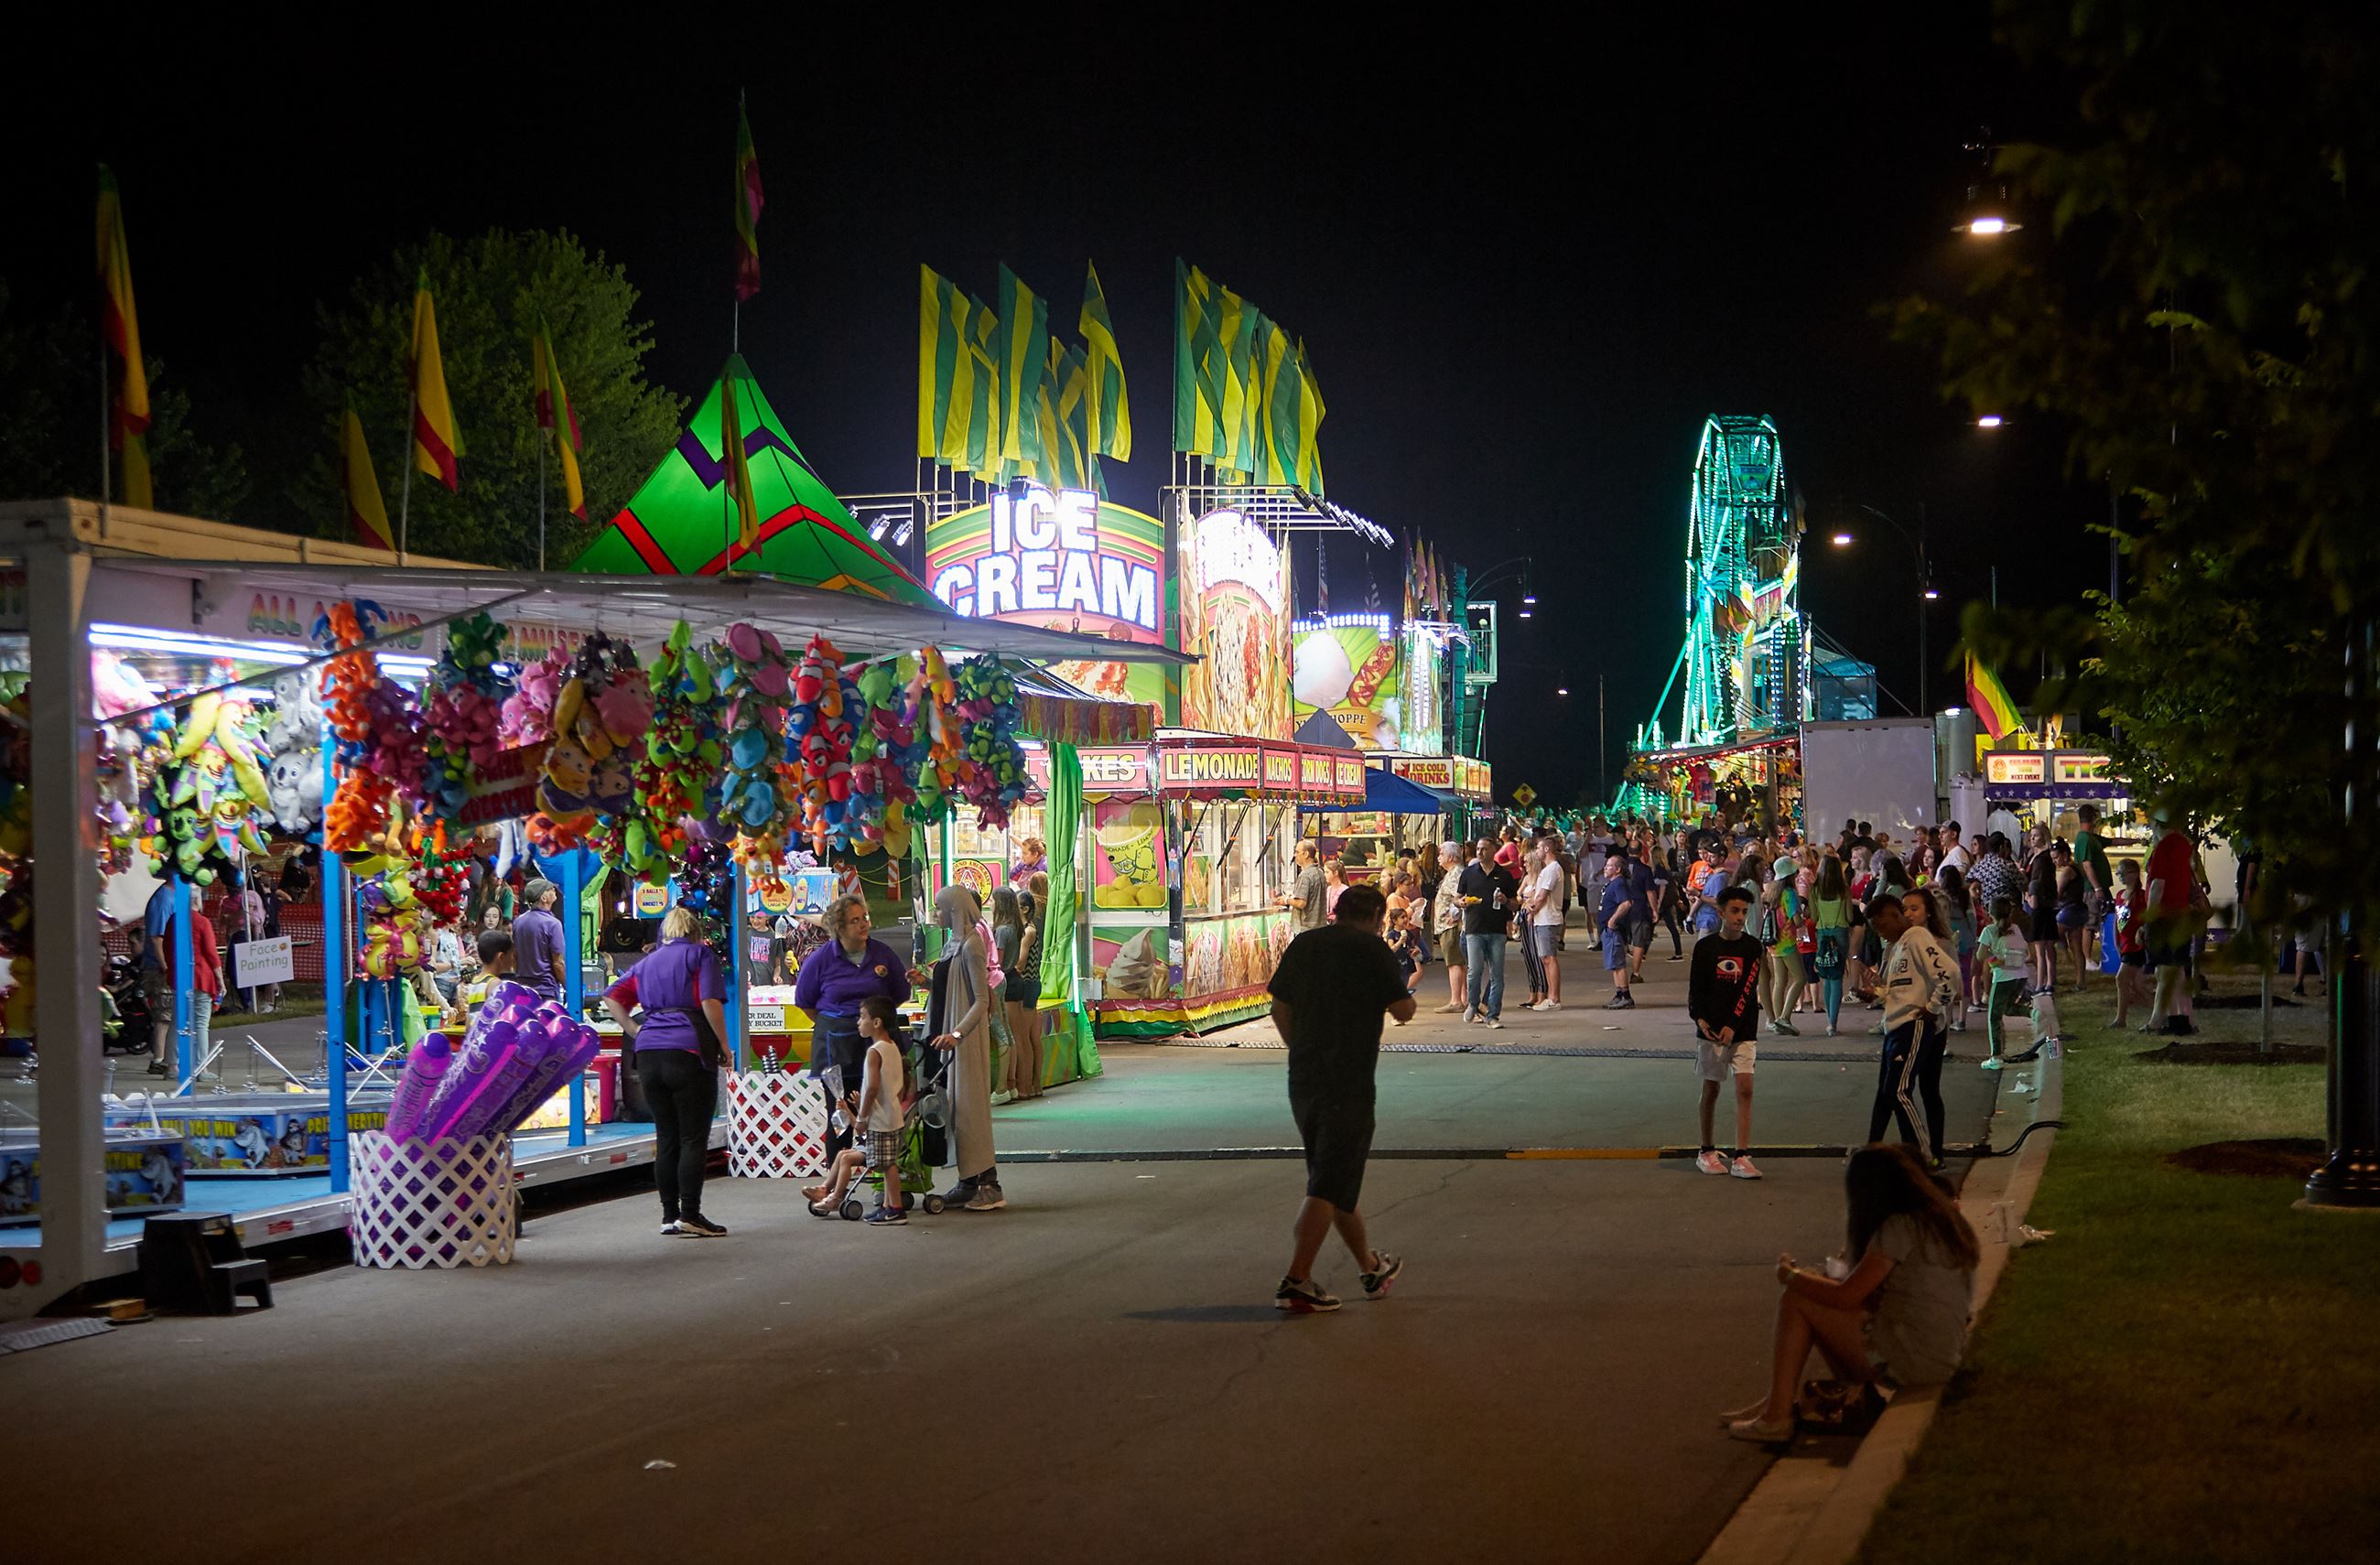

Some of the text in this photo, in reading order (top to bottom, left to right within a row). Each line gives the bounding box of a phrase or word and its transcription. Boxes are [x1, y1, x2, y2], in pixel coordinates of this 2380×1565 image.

[990, 488, 1098, 554] ICE
[932, 549, 1159, 633] CREAM
[247, 593, 302, 637] ALL
[1165, 753, 1259, 782] LEMONADE
[1266, 755, 1293, 782] NACHOS
[1410, 772, 1450, 784] DRINKS
[1412, 763, 1446, 772] ICE COLD
[250, 944, 277, 956] Face
[241, 956, 288, 971] Painting
[189, 1119, 211, 1137] YOU
[213, 1121, 237, 1138] WIN
